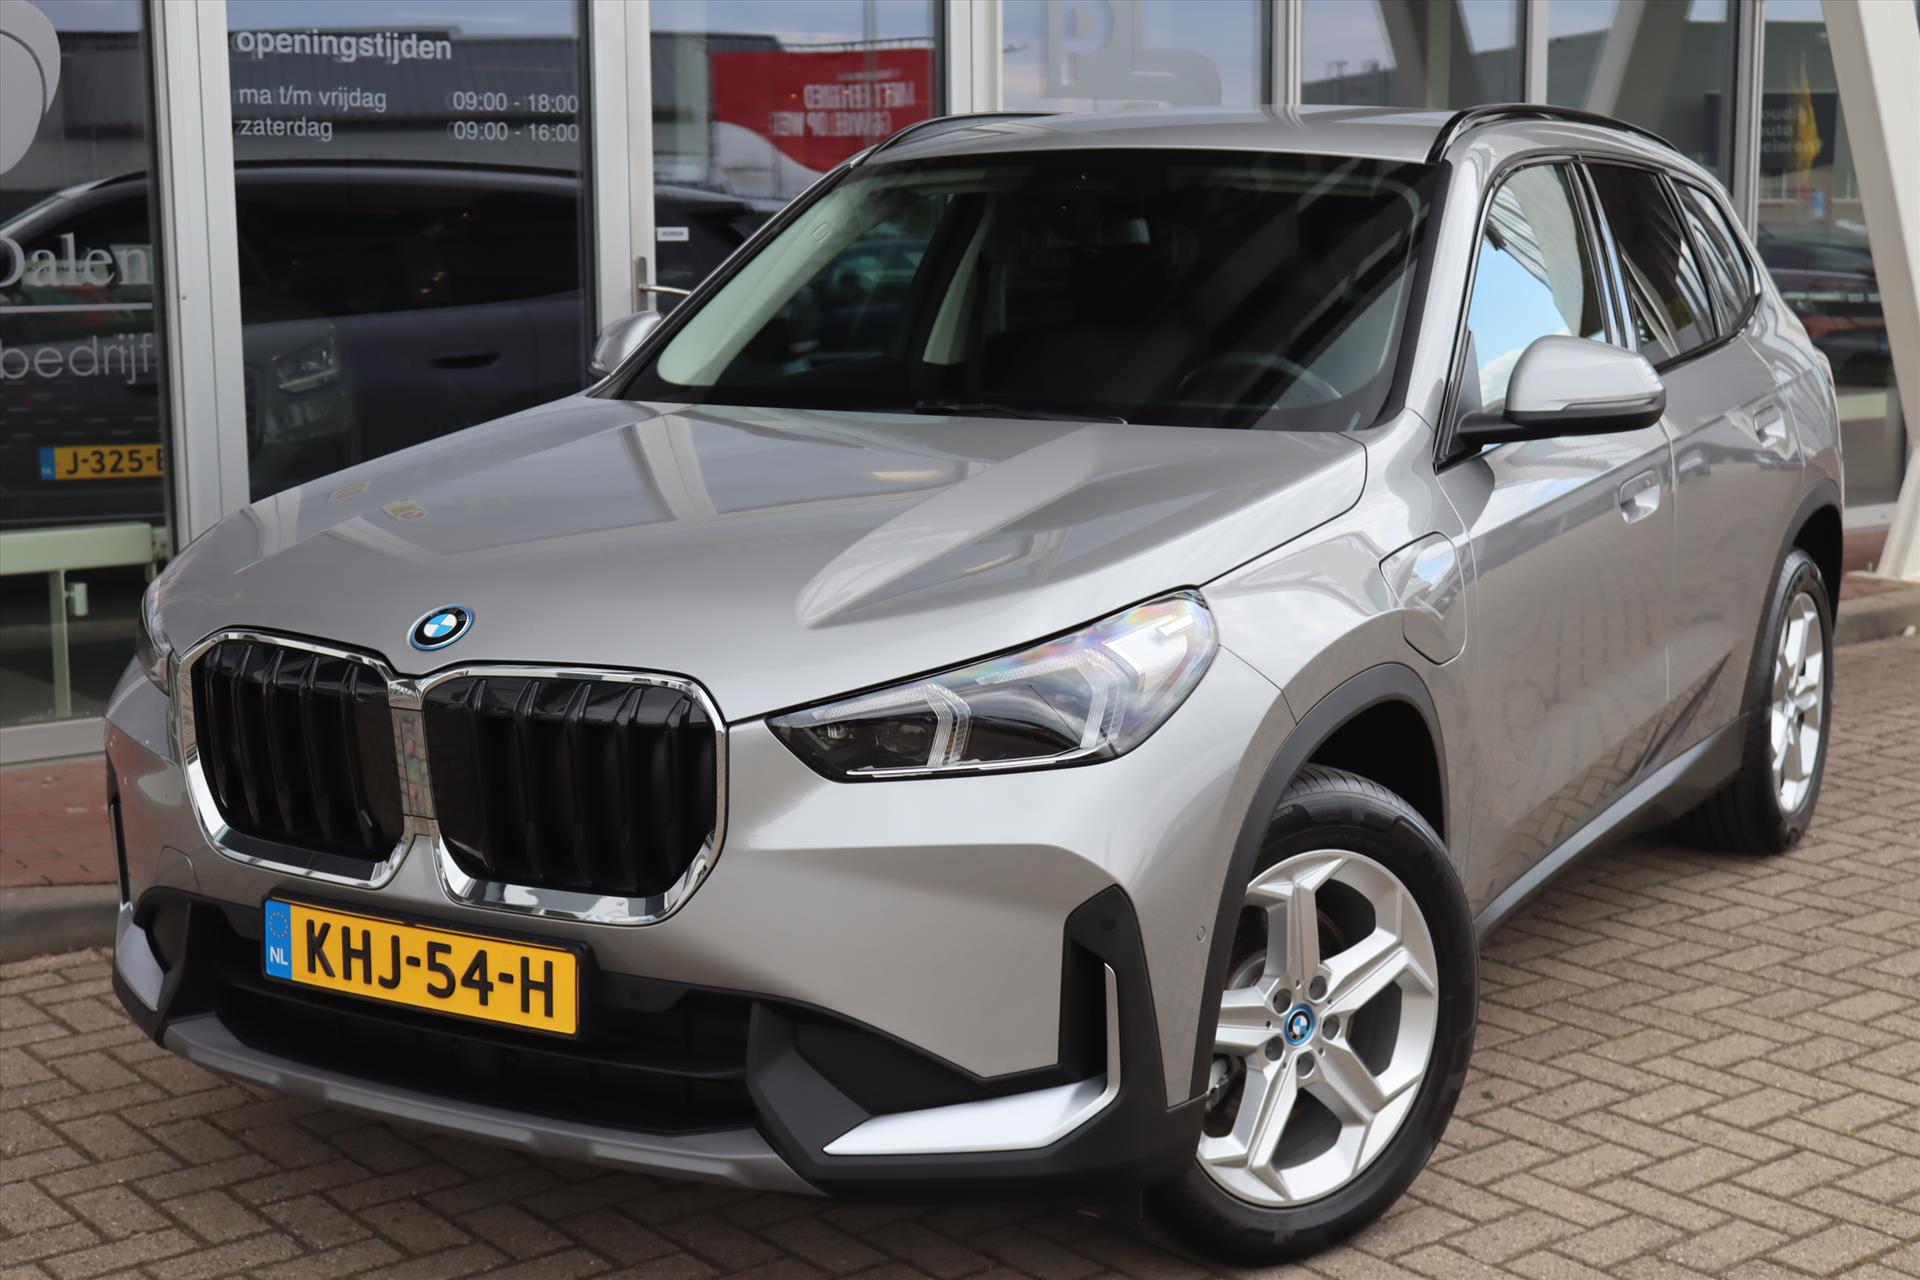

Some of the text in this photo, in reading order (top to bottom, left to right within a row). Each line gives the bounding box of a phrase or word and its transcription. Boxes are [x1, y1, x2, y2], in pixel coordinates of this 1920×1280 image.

[236, 29, 452, 65] openingstijden
[239, 88, 272, 105] ma
[279, 85, 312, 105] t/m
[318, 86, 387, 113] vrijdag
[452, 91, 508, 112] 09:00
[528, 93, 579, 113] 18:00
[240, 116, 333, 142] zaterdag
[453, 121, 509, 141] 09:00
[529, 123, 579, 142] 16:00
[0, 333, 153, 385] bedrijf
[269, 945, 289, 967] NL
[305, 918, 554, 1019] KHJ-54-H
